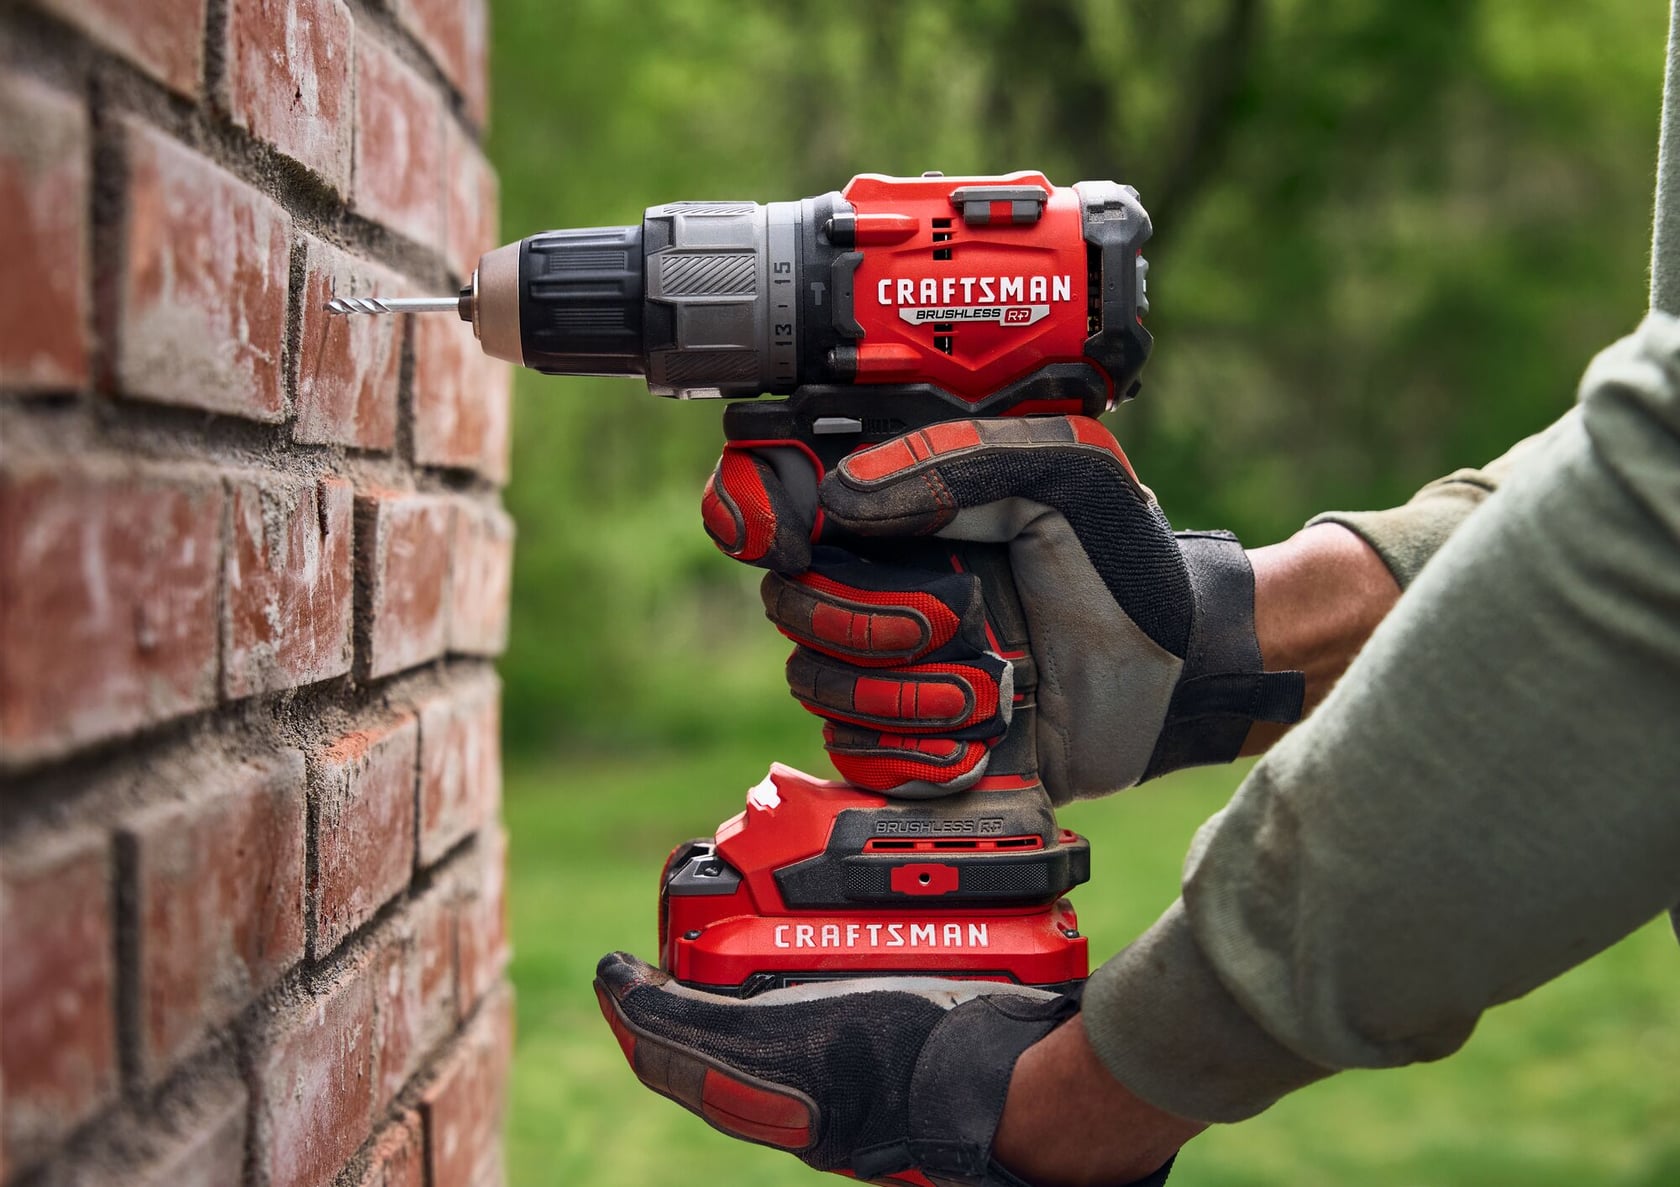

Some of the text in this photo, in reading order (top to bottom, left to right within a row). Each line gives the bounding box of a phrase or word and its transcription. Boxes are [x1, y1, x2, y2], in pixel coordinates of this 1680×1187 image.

[774, 261, 791, 285] 15
[877, 275, 1071, 305] CRAFTSMAN
[916, 308, 1001, 320] BRUSHLESS
[775, 323, 793, 346] 13
[876, 820, 975, 833] BRUSHLESS
[774, 923, 989, 948] CRAFTSMAN
